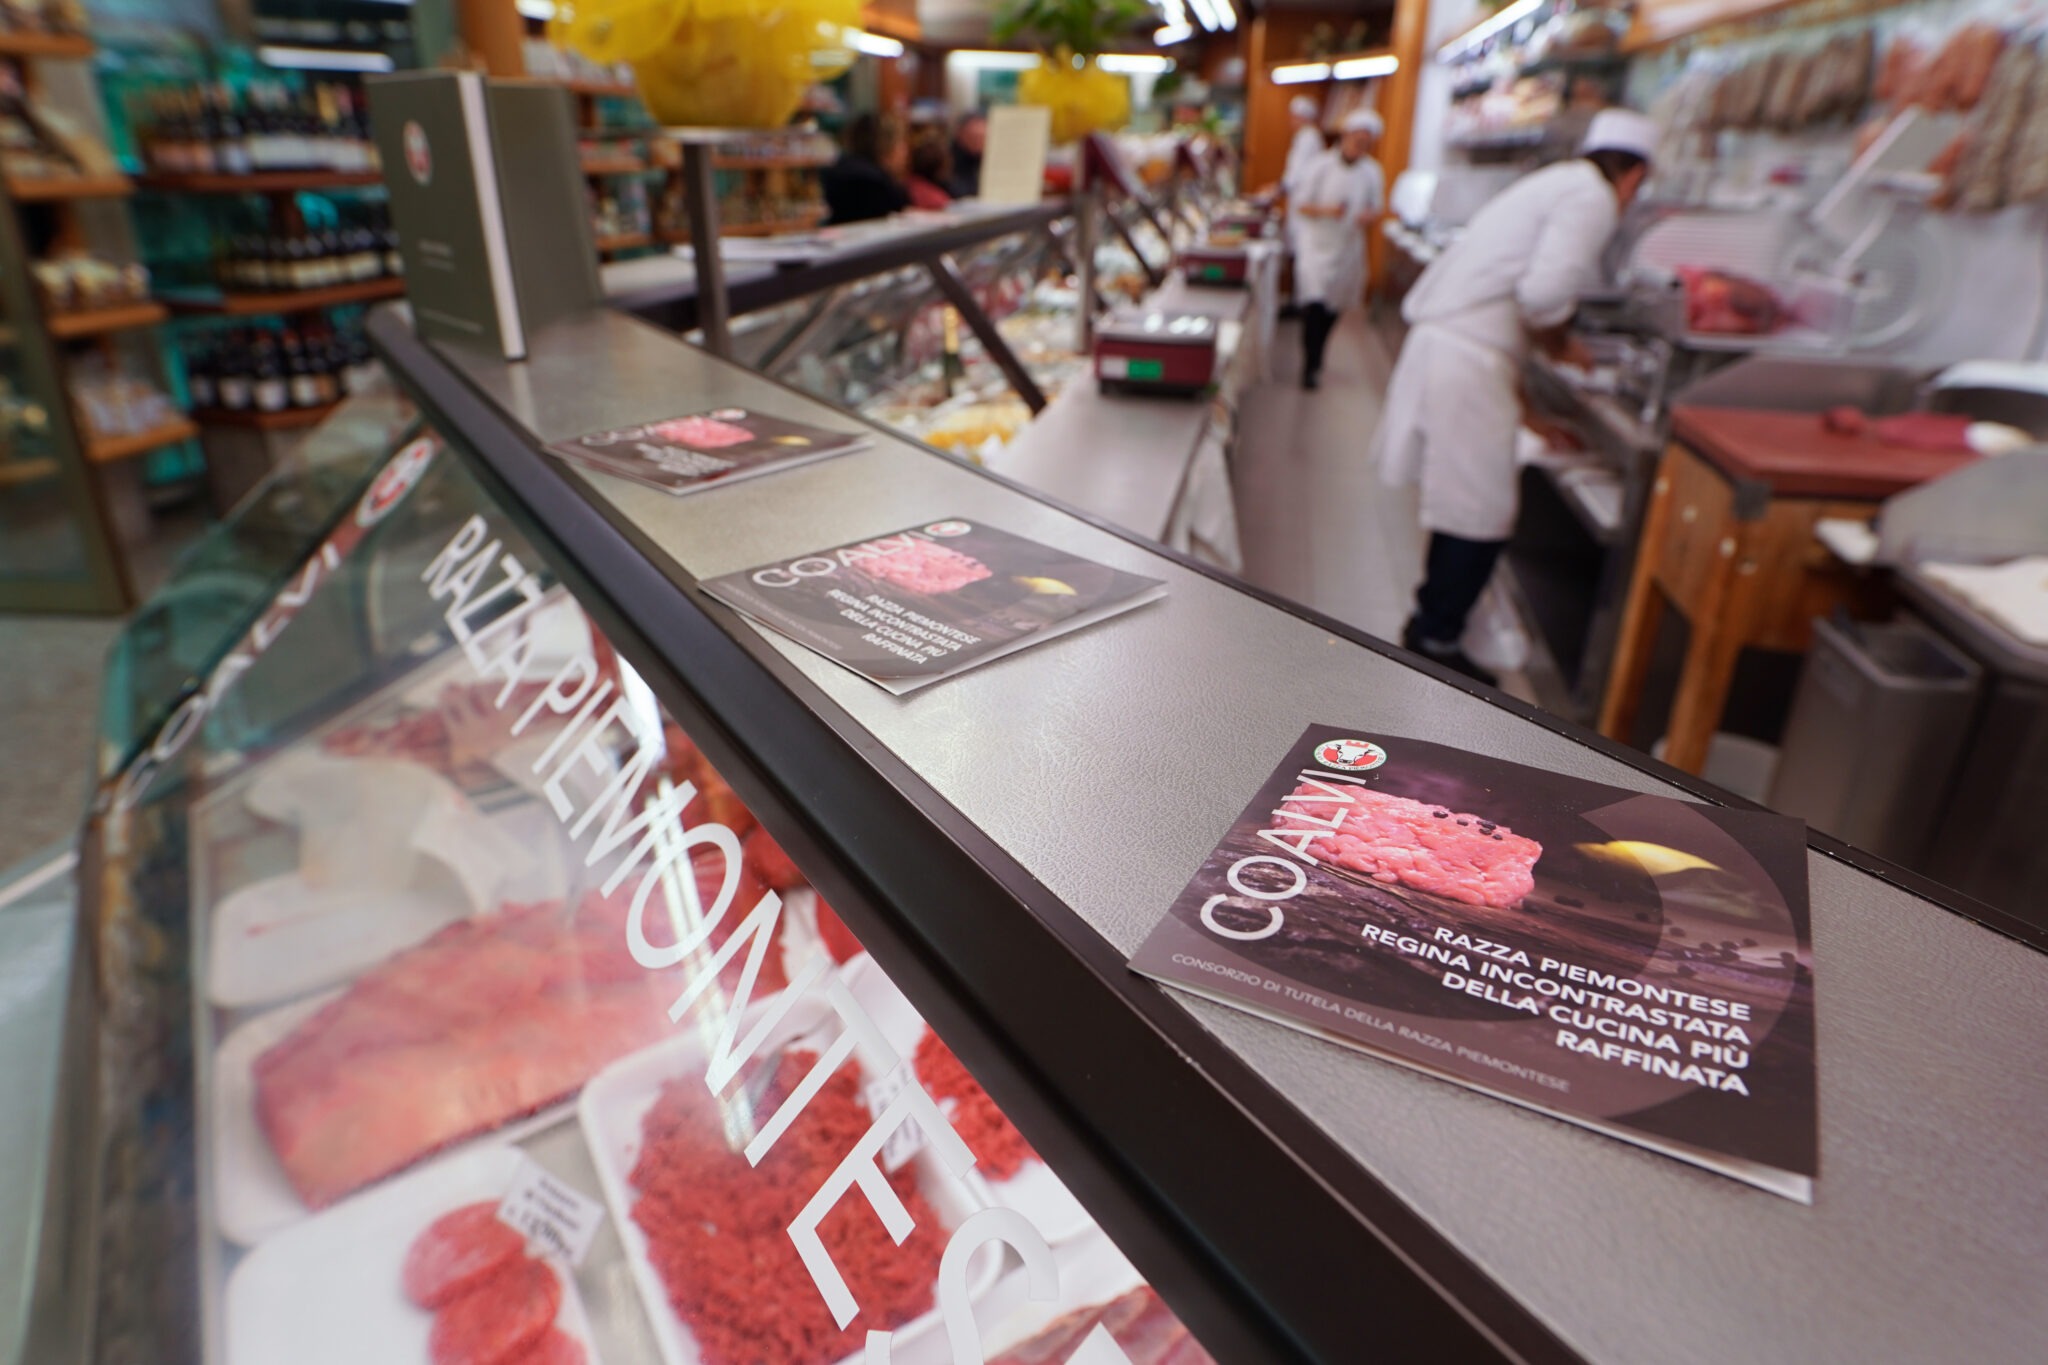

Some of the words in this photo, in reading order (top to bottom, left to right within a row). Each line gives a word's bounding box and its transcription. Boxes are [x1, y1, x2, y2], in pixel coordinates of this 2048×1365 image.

[752, 530, 935, 588] COALVI
[840, 608, 879, 629] DELLA
[875, 625, 924, 648] CUCINA
[861, 633, 928, 665] RAFFINATA
[865, 594, 905, 615] RAZZA
[902, 611, 982, 645] PIEMONTESE
[867, 608, 962, 652] INCONTRASTATA
[1200, 769, 1367, 941] COALVI
[421, 514, 544, 710] RAZZA
[510, 655, 1133, 1365] PIEMONTES
[1433, 926, 1531, 967] RAZZA
[1540, 957, 1752, 1021] PIEMONTESE
[1171, 953, 1261, 986] CONSORZIO
[1263, 979, 1281, 993] DI
[1284, 986, 1342, 1015] TUTELA
[1344, 1007, 1395, 1034] DELLA
[1398, 1025, 1452, 1054] RAZZA
[1455, 1045, 1571, 1094] PIEMONTESE
[1361, 923, 1471, 972] REGINA
[1480, 961, 1752, 1045] INCONTRASTATA
[1442, 971, 1540, 1015] DELLA
[1548, 1004, 1681, 1054] CUCINA
[1690, 1039, 1750, 1069] PIÙ
[1556, 1030, 1750, 1096] RAFFINATA
